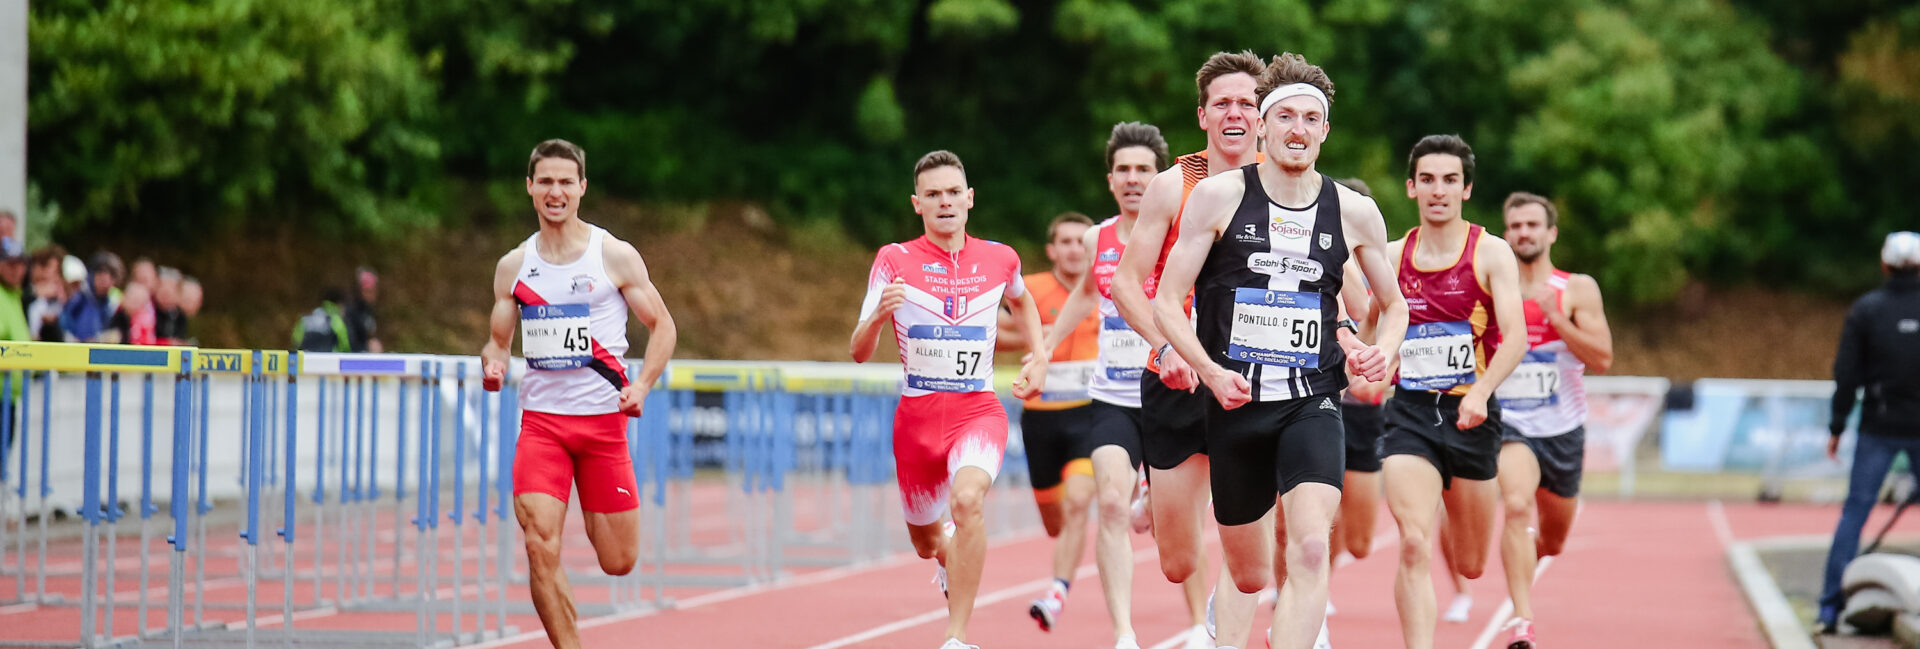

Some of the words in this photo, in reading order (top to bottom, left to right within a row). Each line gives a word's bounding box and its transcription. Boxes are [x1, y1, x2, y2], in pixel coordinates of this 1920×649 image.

[1270, 222, 1311, 237] Sojasun
[1254, 258, 1279, 268] Sobhi
[1291, 264, 1317, 274] sport
[925, 276, 948, 284] STADE
[1283, 318, 1288, 327] G
[553, 328, 558, 336] A
[564, 327, 589, 352] 45
[1290, 320, 1318, 348] 50
[948, 350, 951, 358] L
[1447, 344, 1472, 370] 42
[956, 351, 981, 376] 57
[1537, 371, 1557, 393] 12
